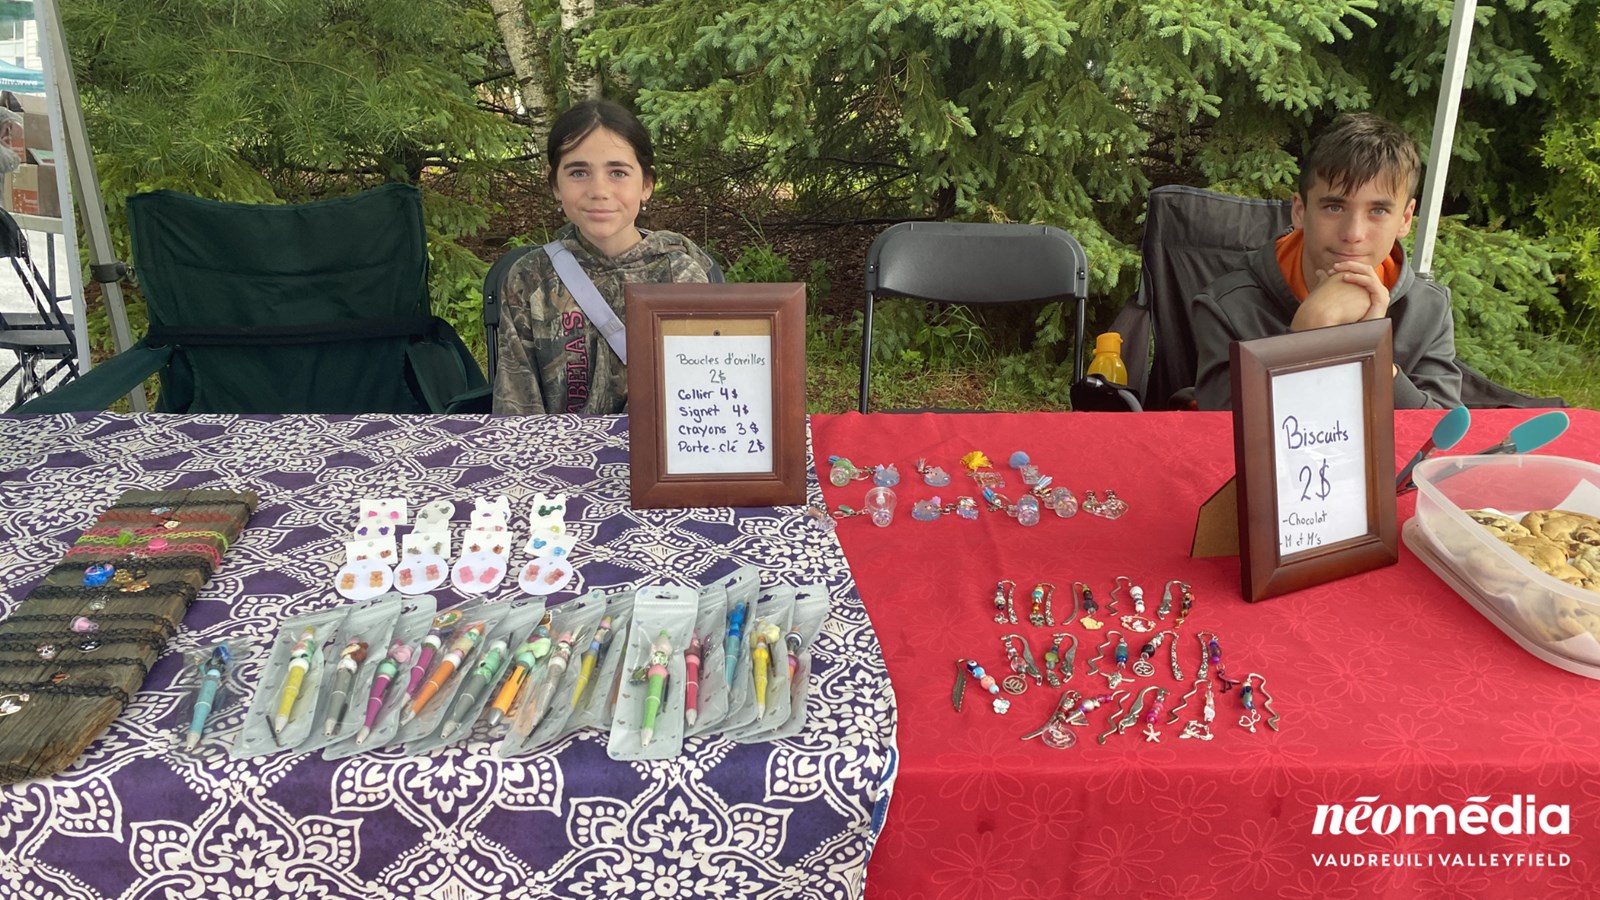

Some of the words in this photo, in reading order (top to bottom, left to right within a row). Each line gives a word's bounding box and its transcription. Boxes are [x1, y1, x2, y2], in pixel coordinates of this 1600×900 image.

[676, 353, 719, 365] Boucles
[724, 352, 766, 366] d'oreilles
[678, 388, 714, 401] Collier
[1282, 415, 1349, 450] Biscuits
[1299, 458, 1331, 502] 2$
